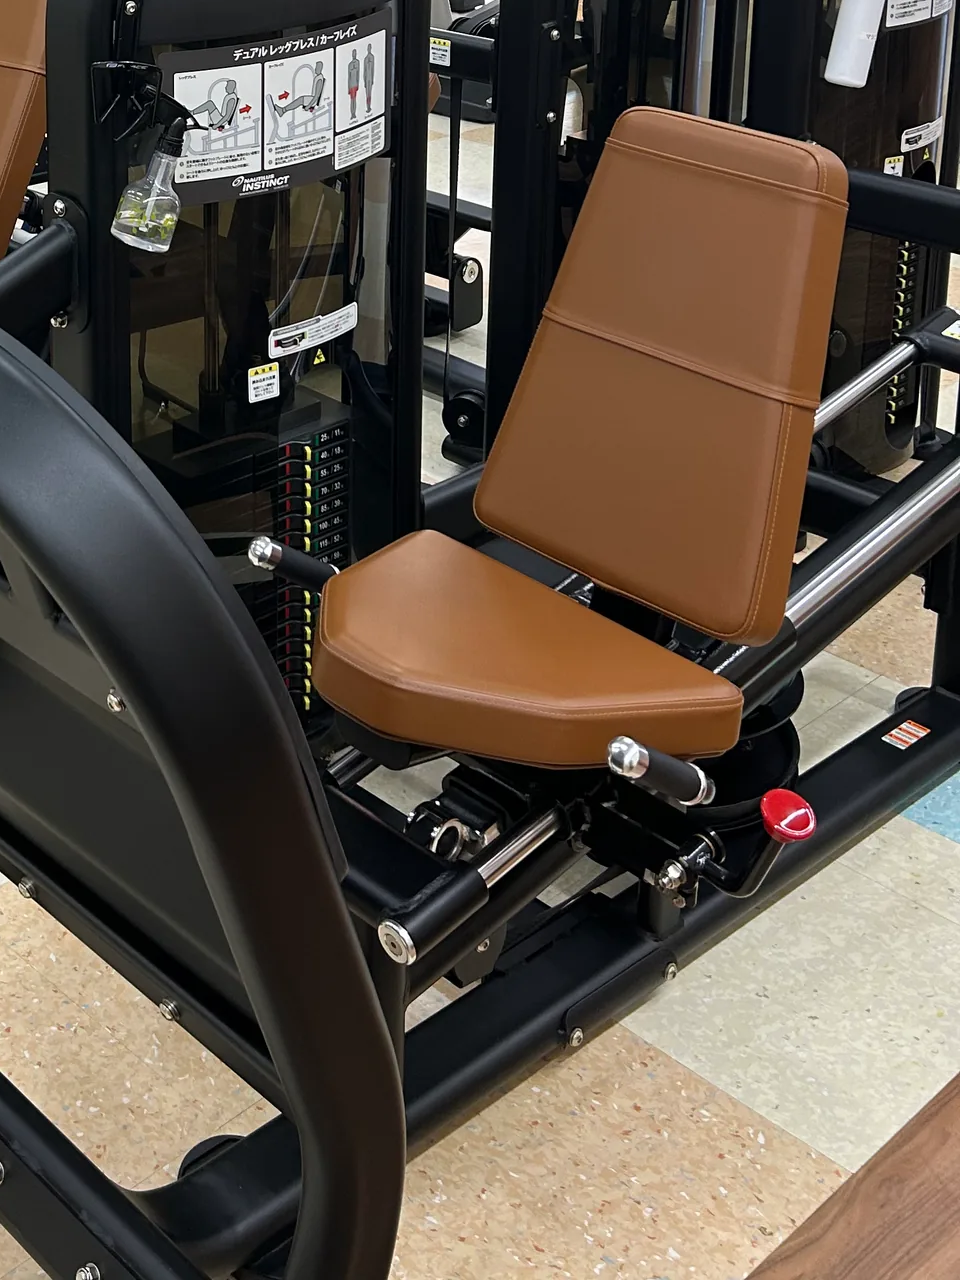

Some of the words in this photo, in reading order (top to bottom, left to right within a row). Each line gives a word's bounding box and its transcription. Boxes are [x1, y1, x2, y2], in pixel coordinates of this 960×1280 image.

[232, 46, 268, 61] デュアル
[242, 176, 290, 192] INSTINCT
